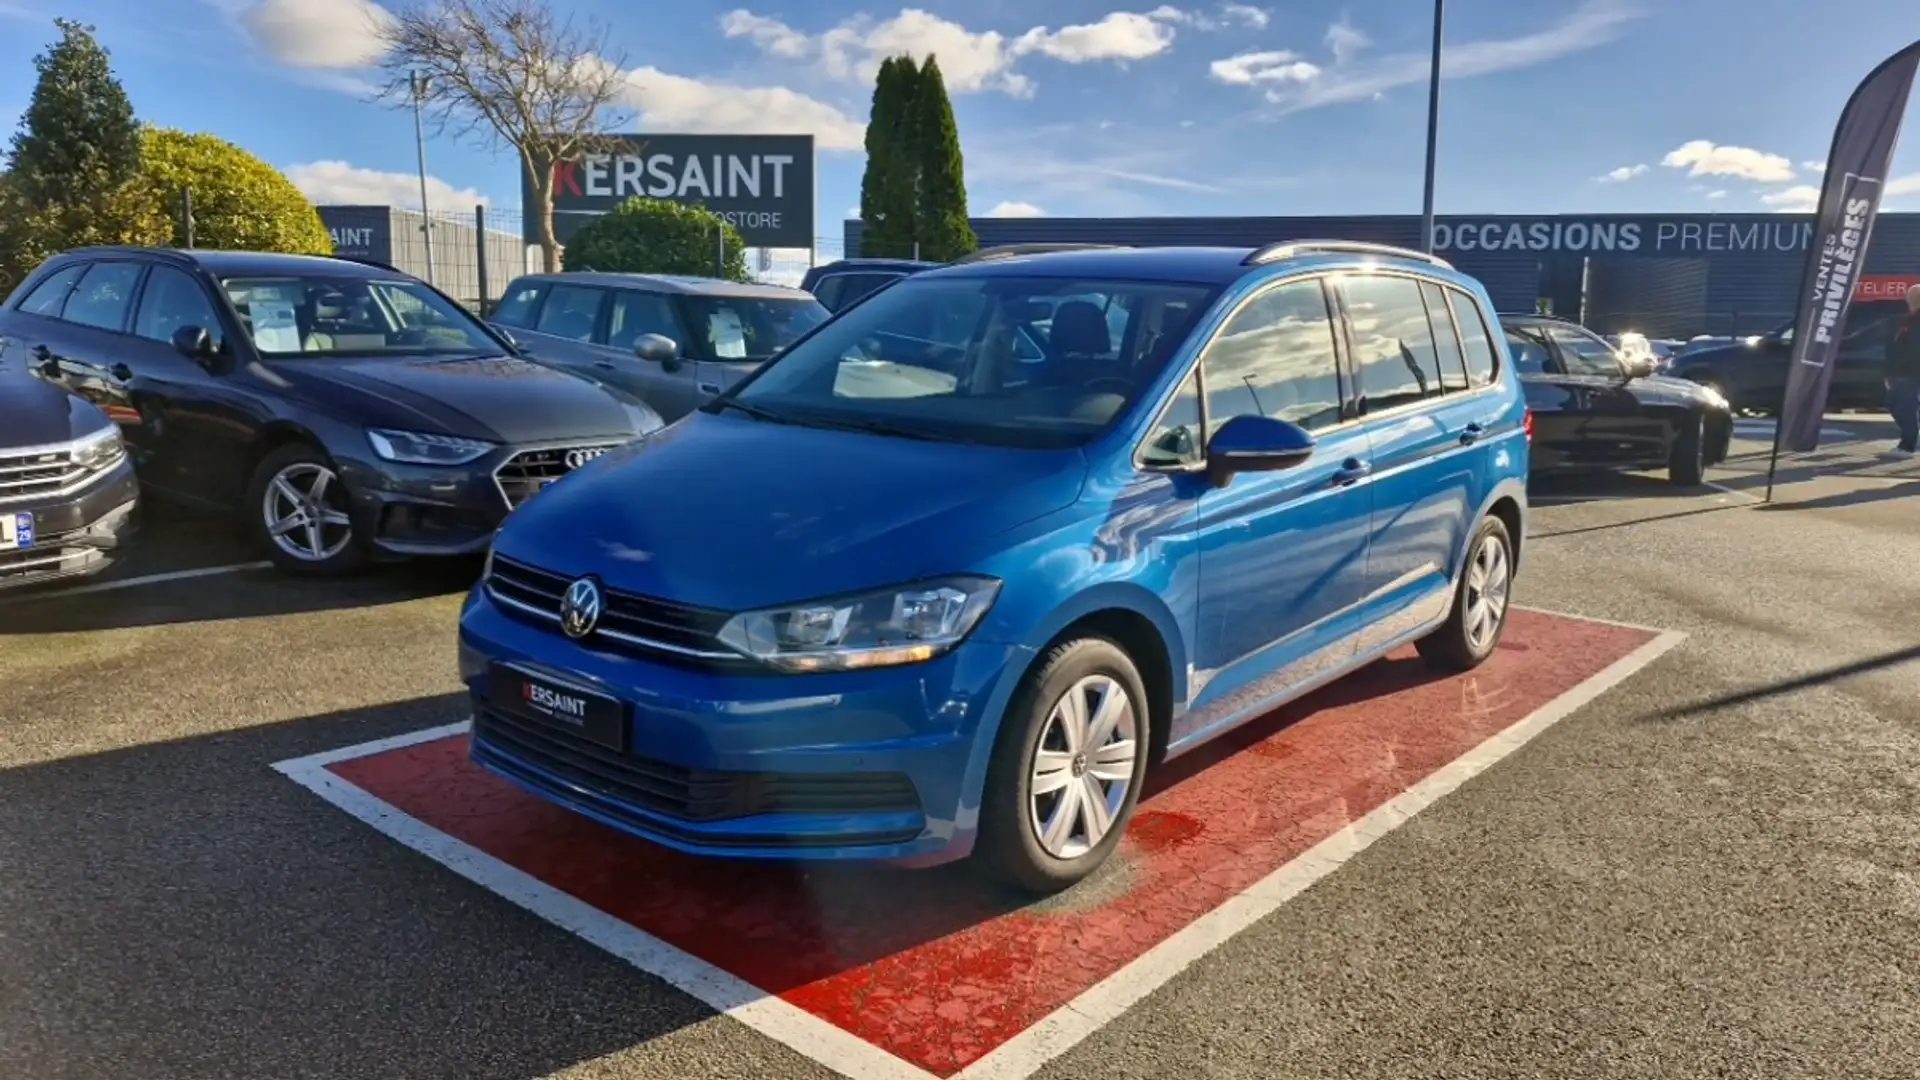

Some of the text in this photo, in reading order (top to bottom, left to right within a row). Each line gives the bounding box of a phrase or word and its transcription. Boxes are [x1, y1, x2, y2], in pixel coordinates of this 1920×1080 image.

[554, 153, 794, 198] KERSAINT
[707, 211, 782, 229] OSTORE
[1433, 223, 1641, 251] OCCASIONS
[1812, 233, 1837, 301] VENTES
[523, 681, 587, 717] KERSAINT
